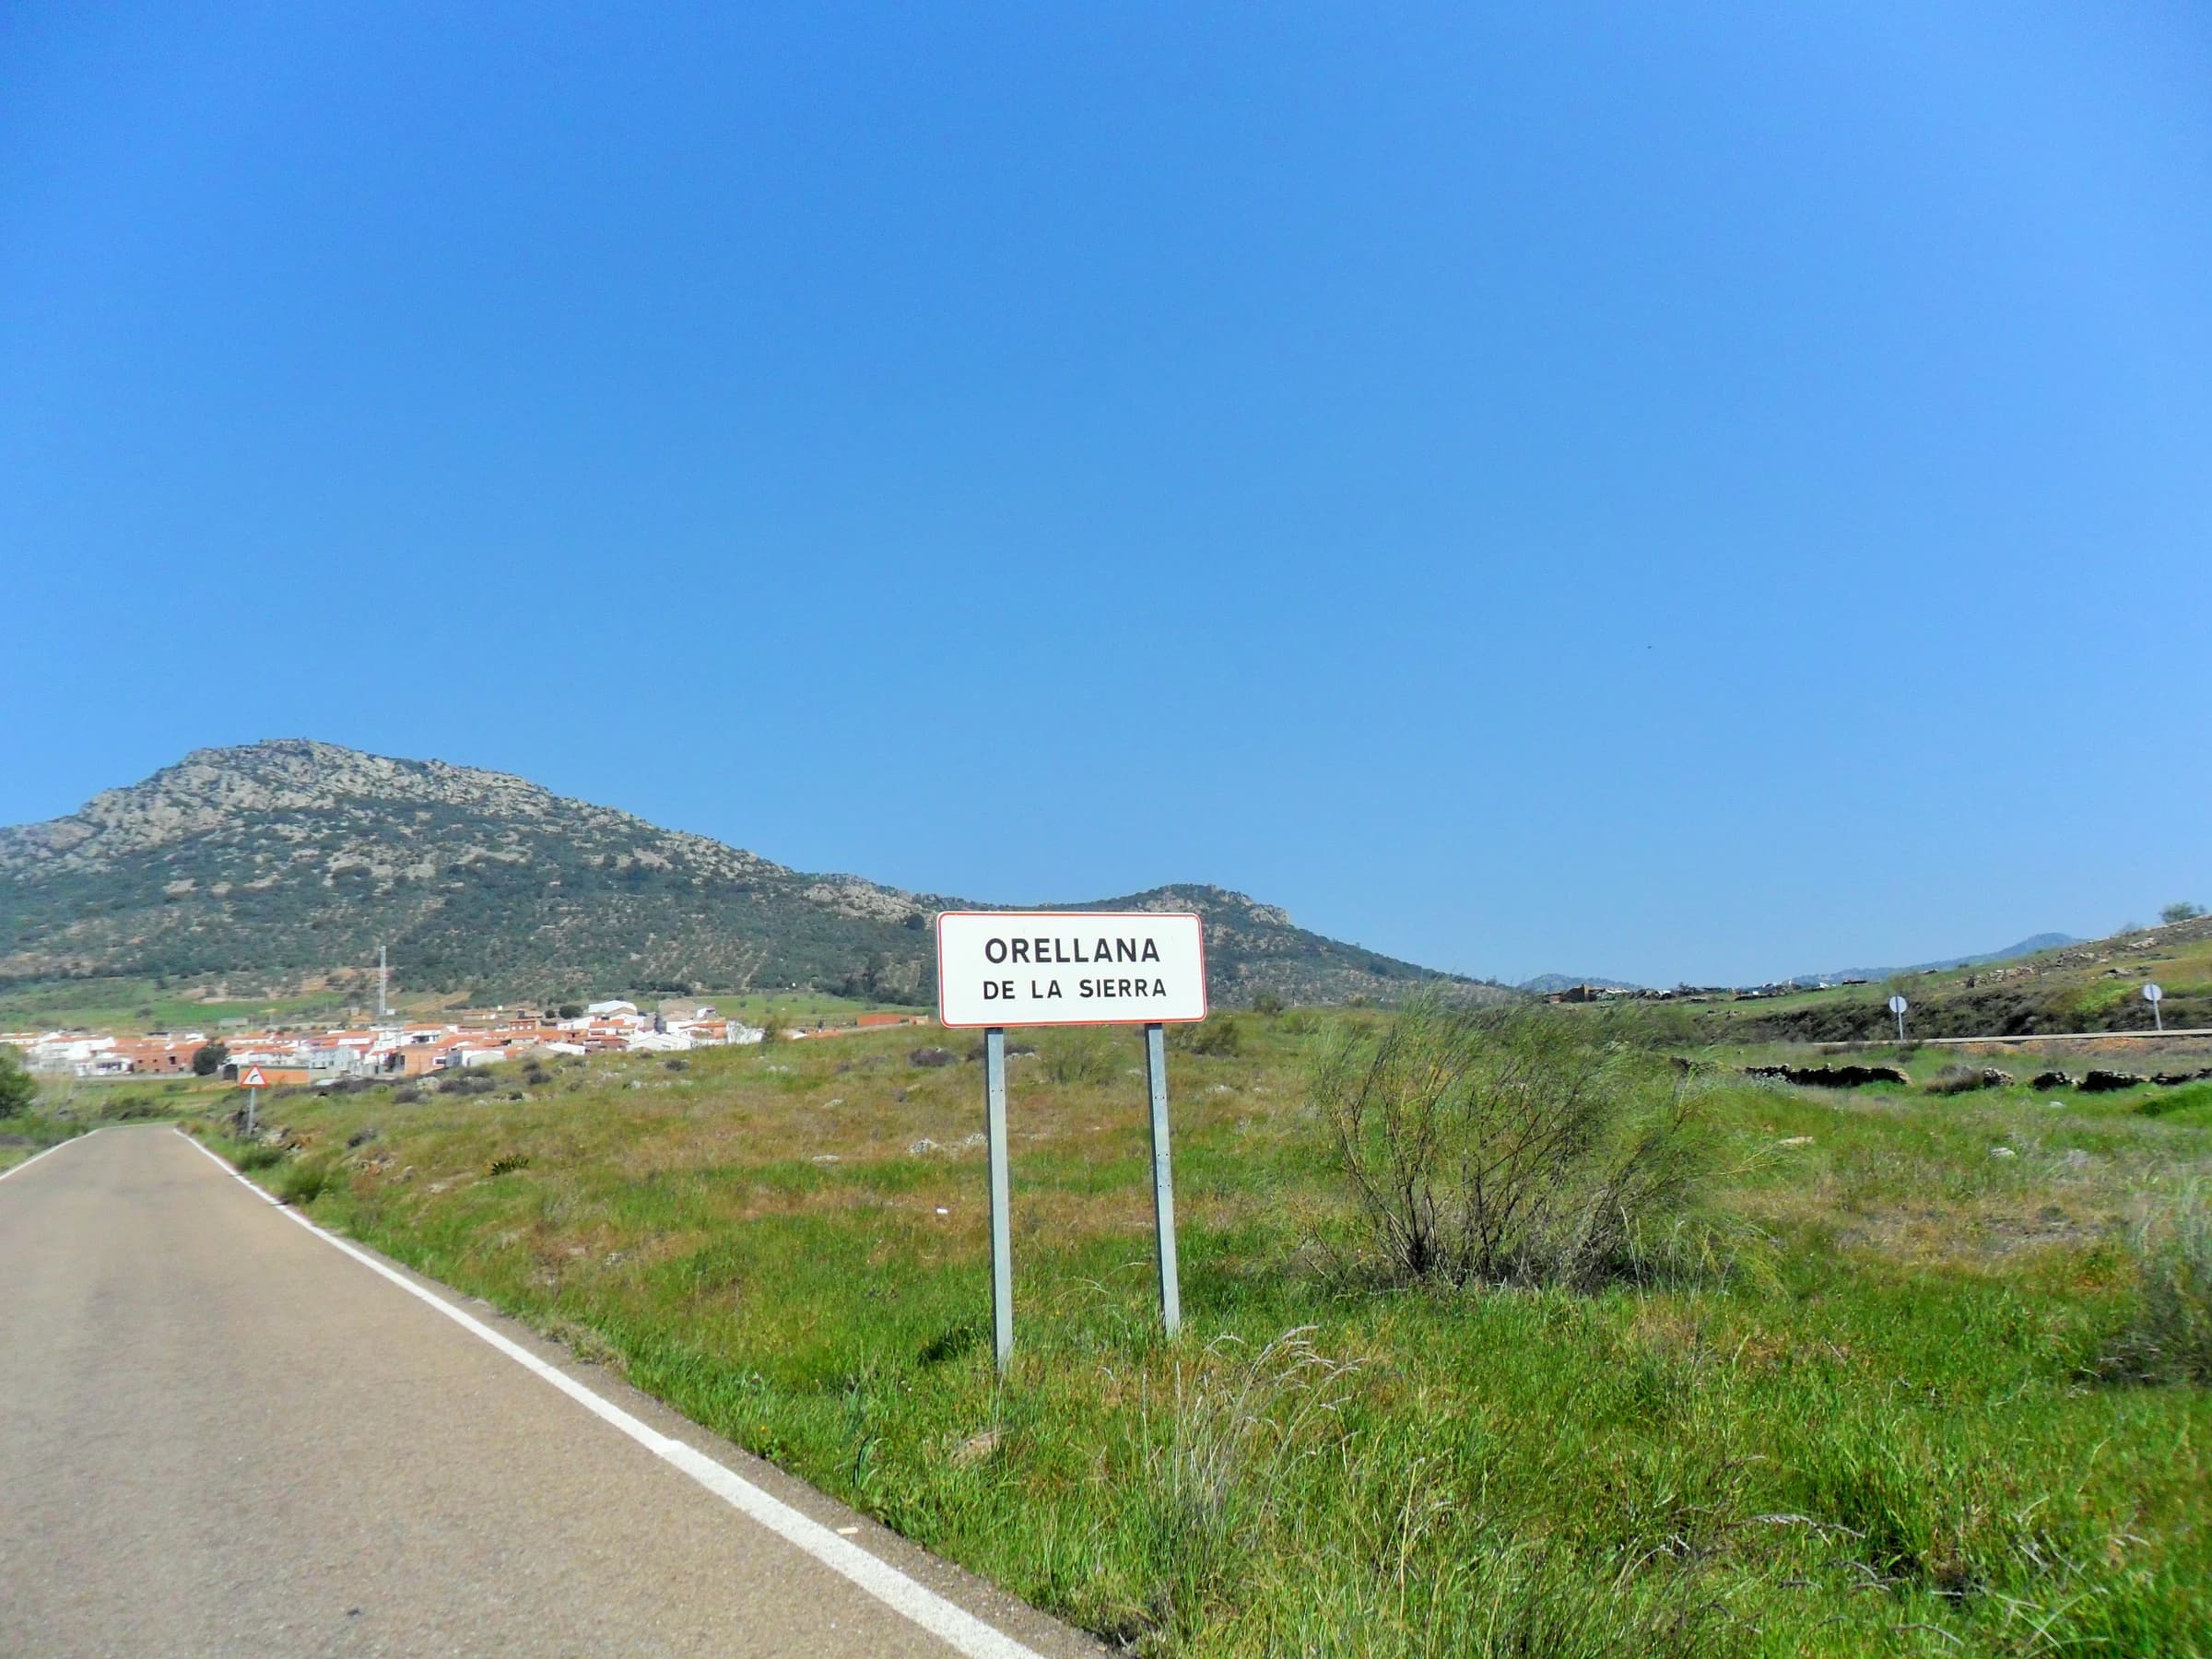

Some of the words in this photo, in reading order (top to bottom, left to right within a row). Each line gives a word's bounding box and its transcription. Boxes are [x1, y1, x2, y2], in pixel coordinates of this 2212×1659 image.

[985, 937, 1160, 964] ORELLANA
[983, 980, 1016, 1000] DE
[1031, 980, 1063, 999] LA
[1079, 978, 1167, 998] SIERRA
